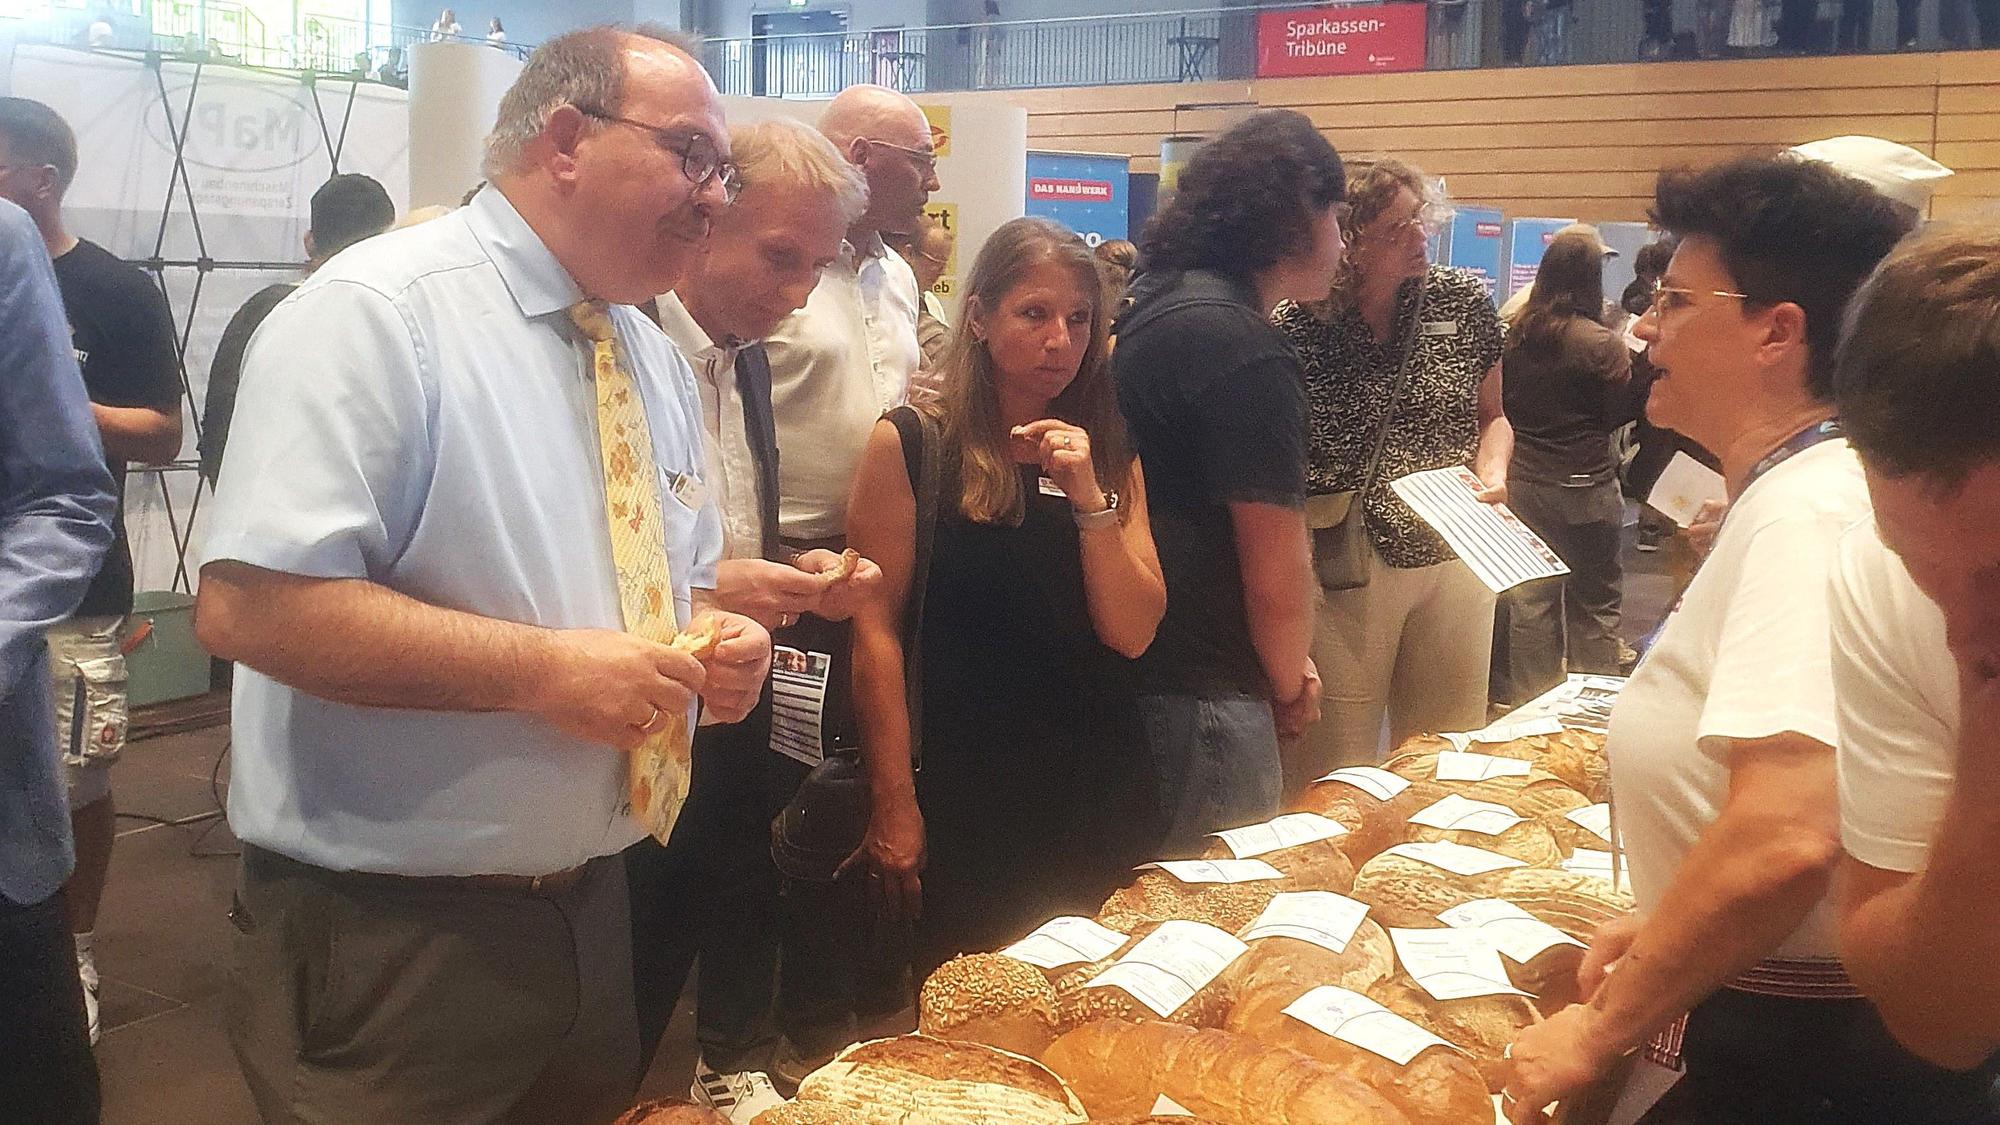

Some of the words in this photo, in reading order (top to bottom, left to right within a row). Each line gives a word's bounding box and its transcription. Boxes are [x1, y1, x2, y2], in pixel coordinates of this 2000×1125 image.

[1286, 18, 1386, 39] Sparkassen-
[1286, 40, 1348, 57] Tribüne
[1034, 184, 1054, 193] DAS
[1056, 182, 1108, 196] HANDWERK
